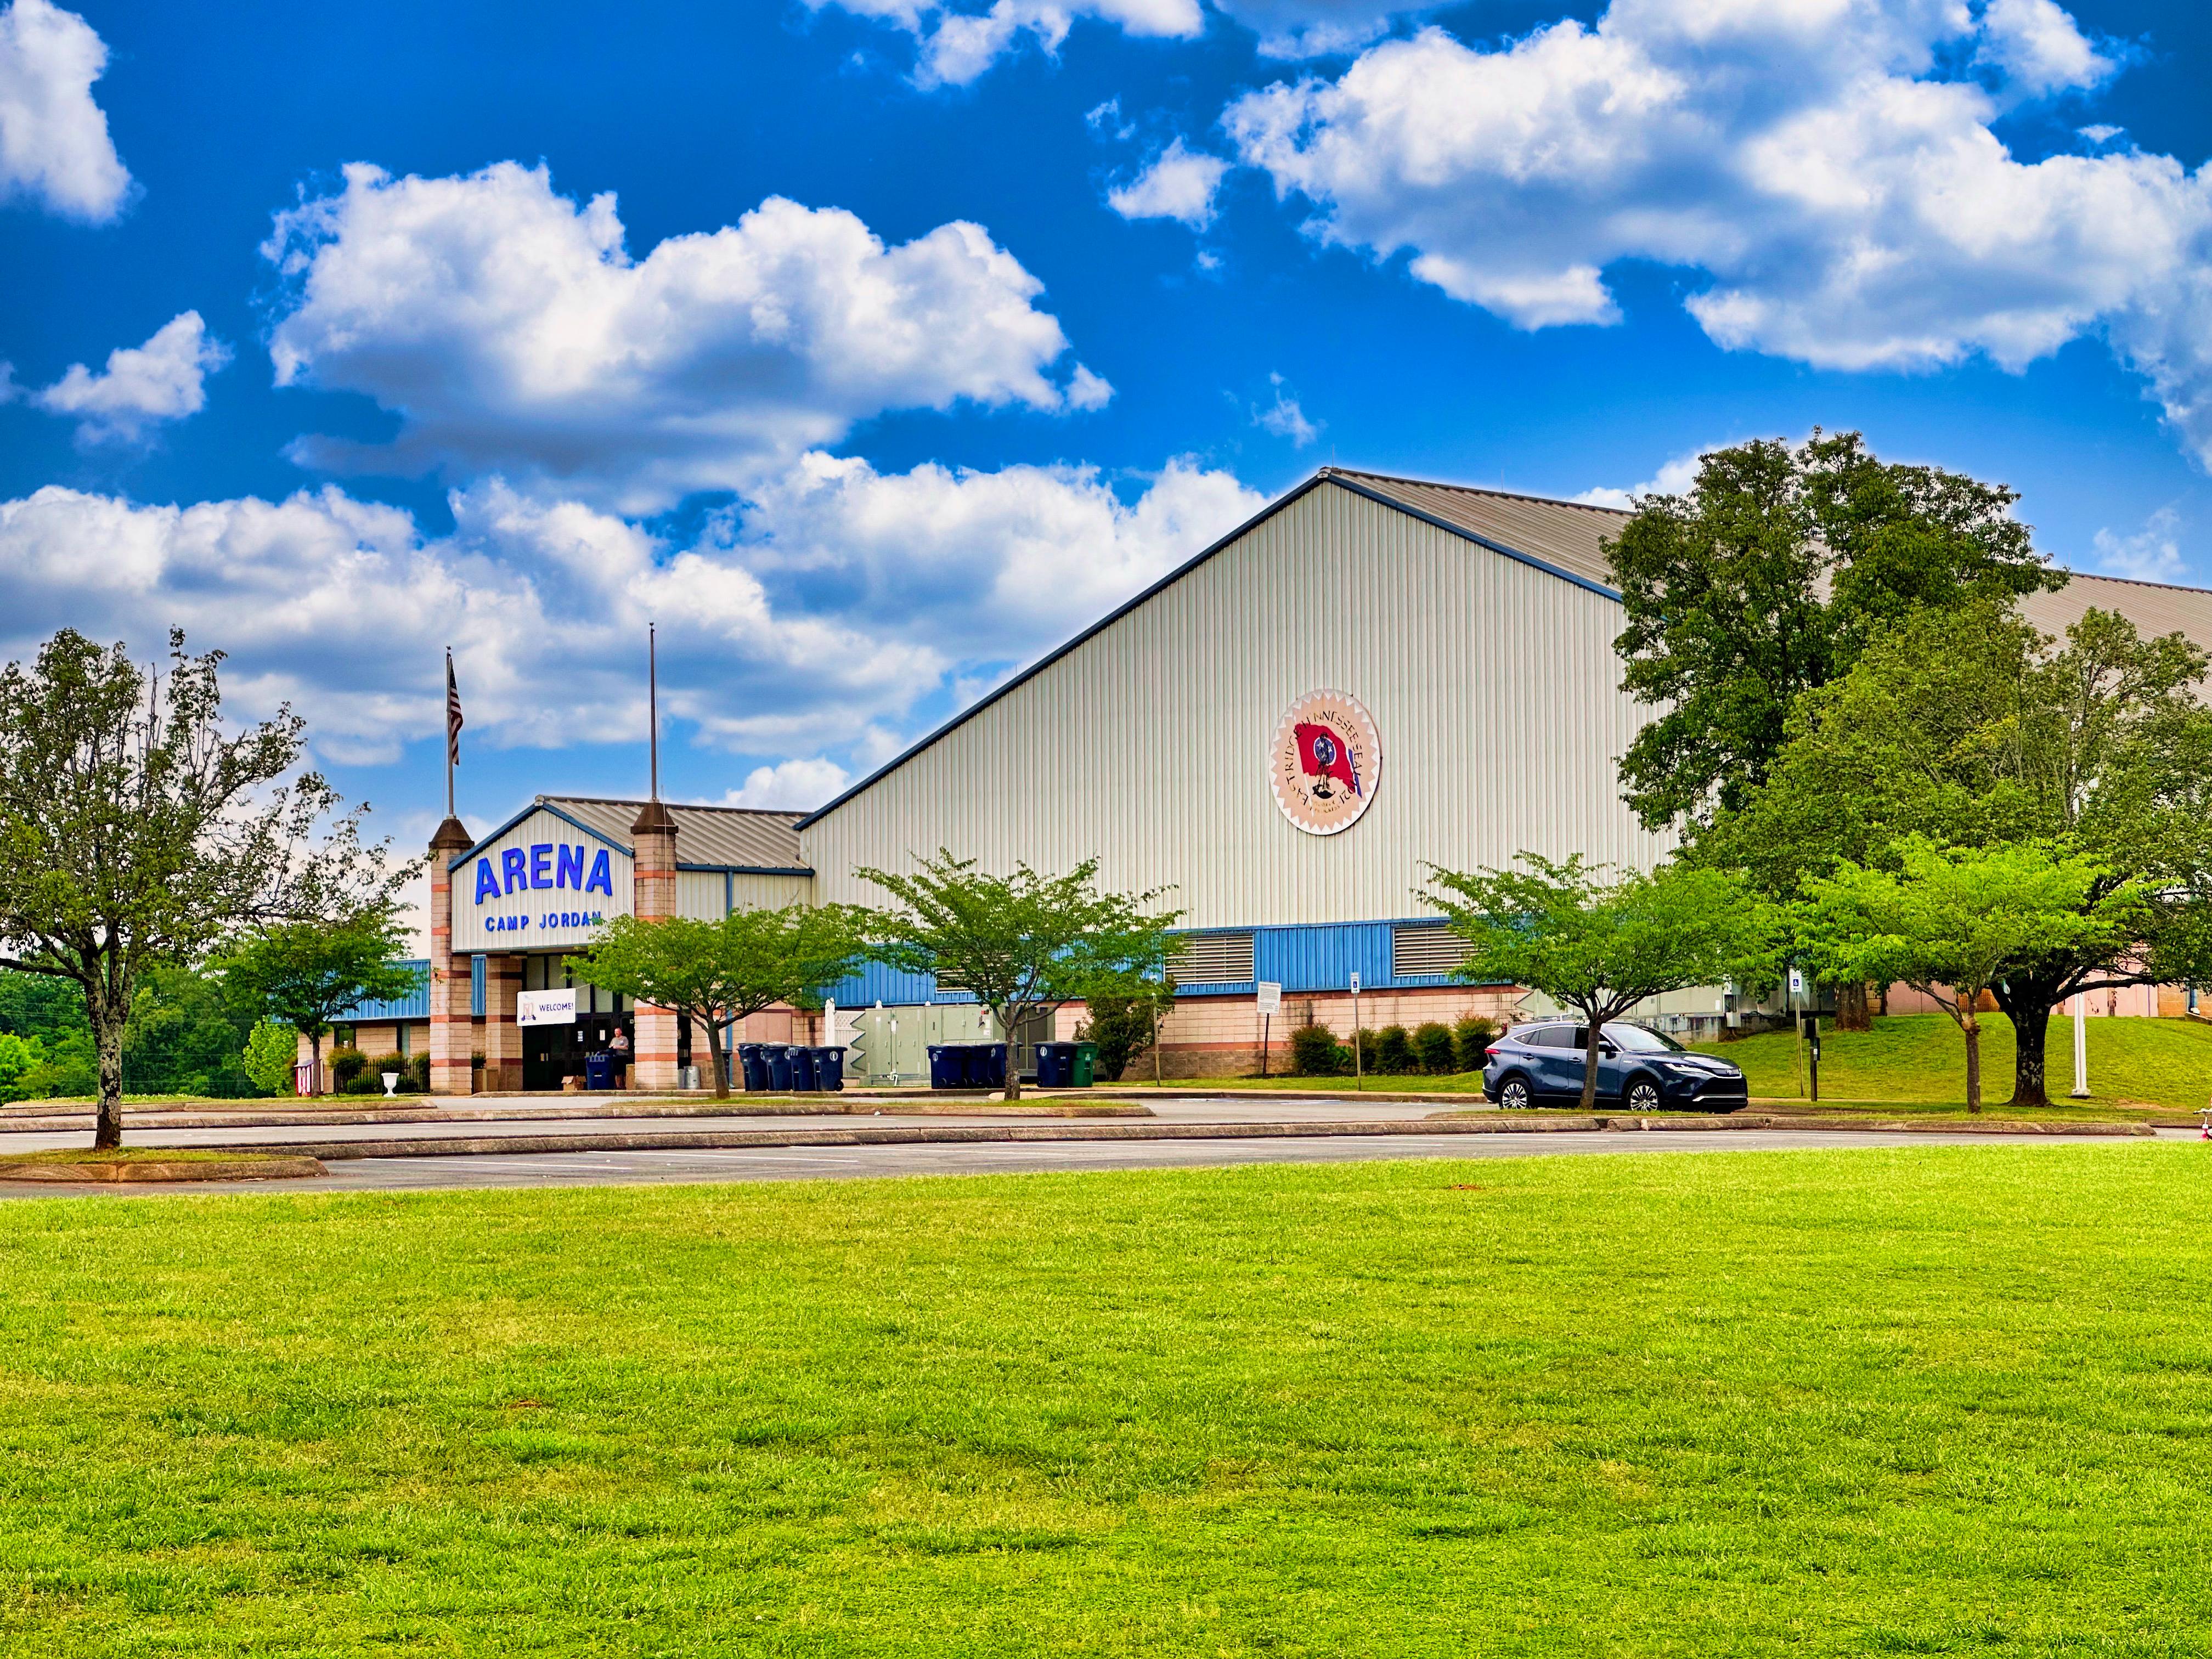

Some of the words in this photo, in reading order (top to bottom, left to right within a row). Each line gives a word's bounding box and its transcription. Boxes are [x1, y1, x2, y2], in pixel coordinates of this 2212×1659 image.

[475, 843, 613, 905] ARENA
[485, 915, 529, 932] CAMP
[539, 1002, 574, 1012] WELCOME!
